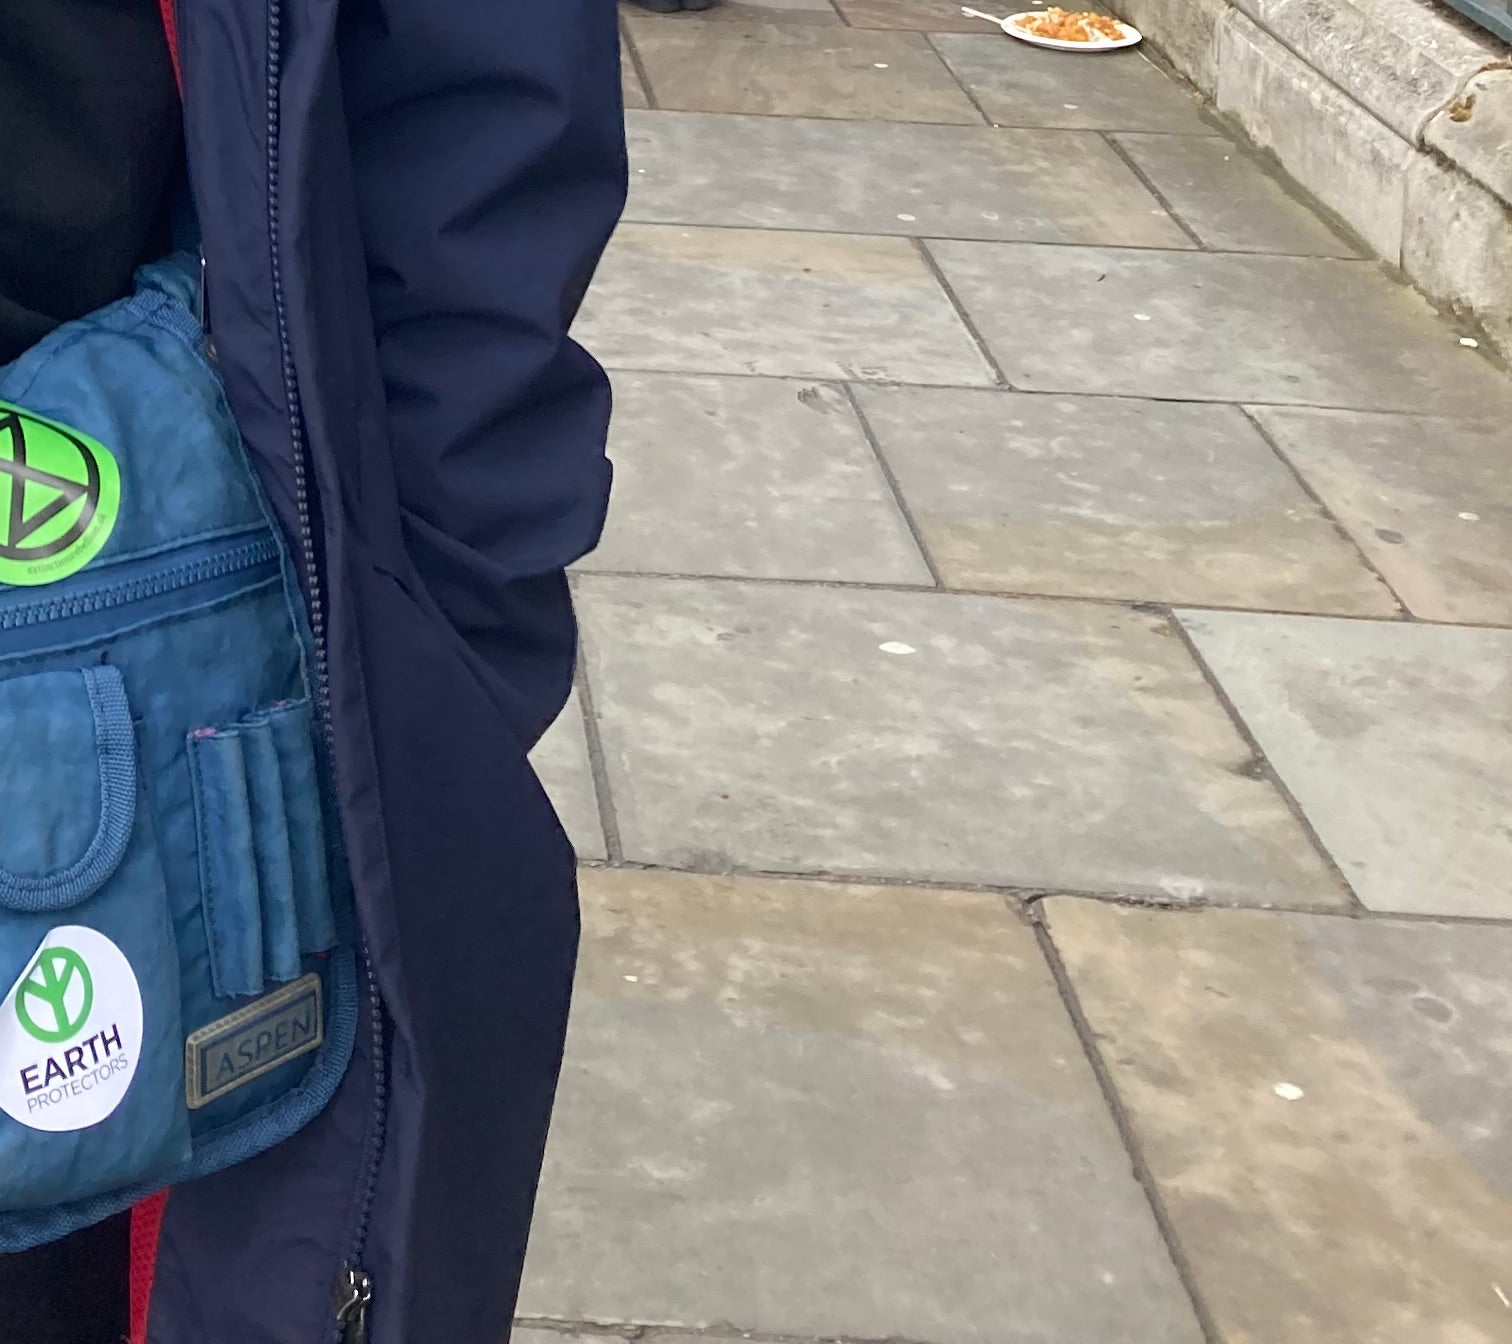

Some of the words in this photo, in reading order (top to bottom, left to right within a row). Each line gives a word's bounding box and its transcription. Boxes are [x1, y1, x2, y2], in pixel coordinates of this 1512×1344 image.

[20, 1023, 123, 1095] EARTH
[215, 1012, 311, 1081] ASPEN
[27, 1053, 129, 1114] PROTECTORS
